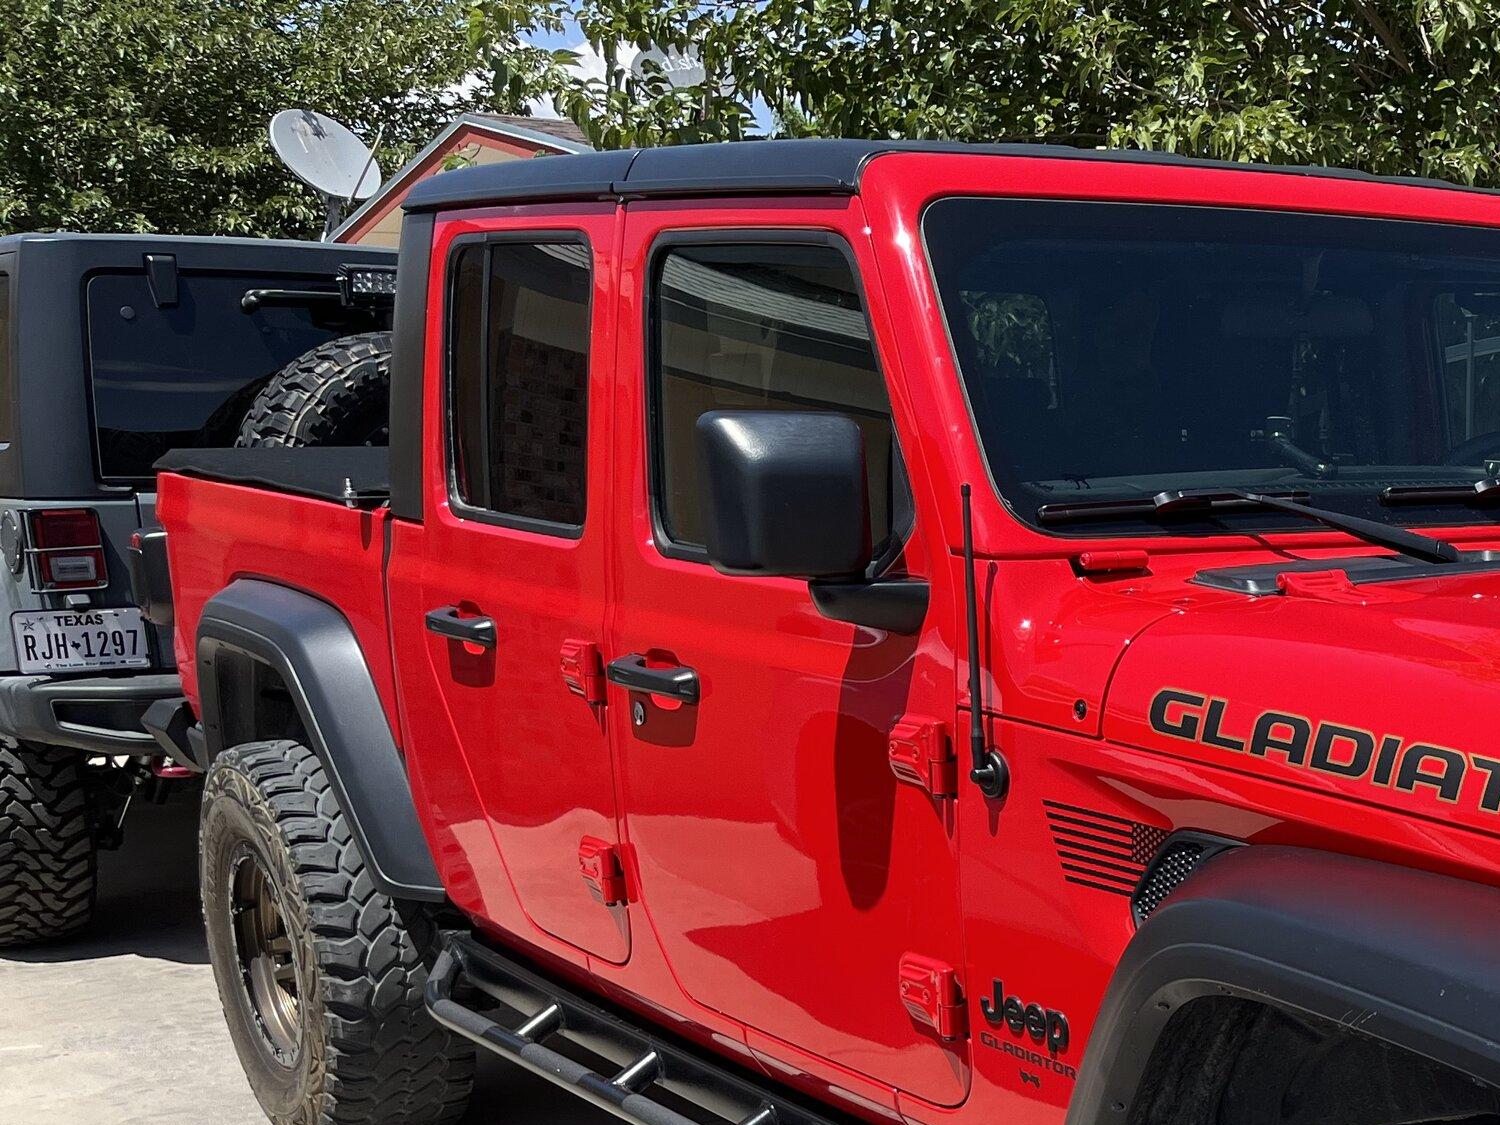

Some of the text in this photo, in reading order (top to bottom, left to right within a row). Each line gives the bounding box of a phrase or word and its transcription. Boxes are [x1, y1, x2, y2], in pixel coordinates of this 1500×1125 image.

[54, 615, 103, 626] TEXAS
[24, 630, 138, 661] RJH 1297
[980, 978, 1070, 1056] Jeep
[980, 1032, 1077, 1080] GLADIATOR
